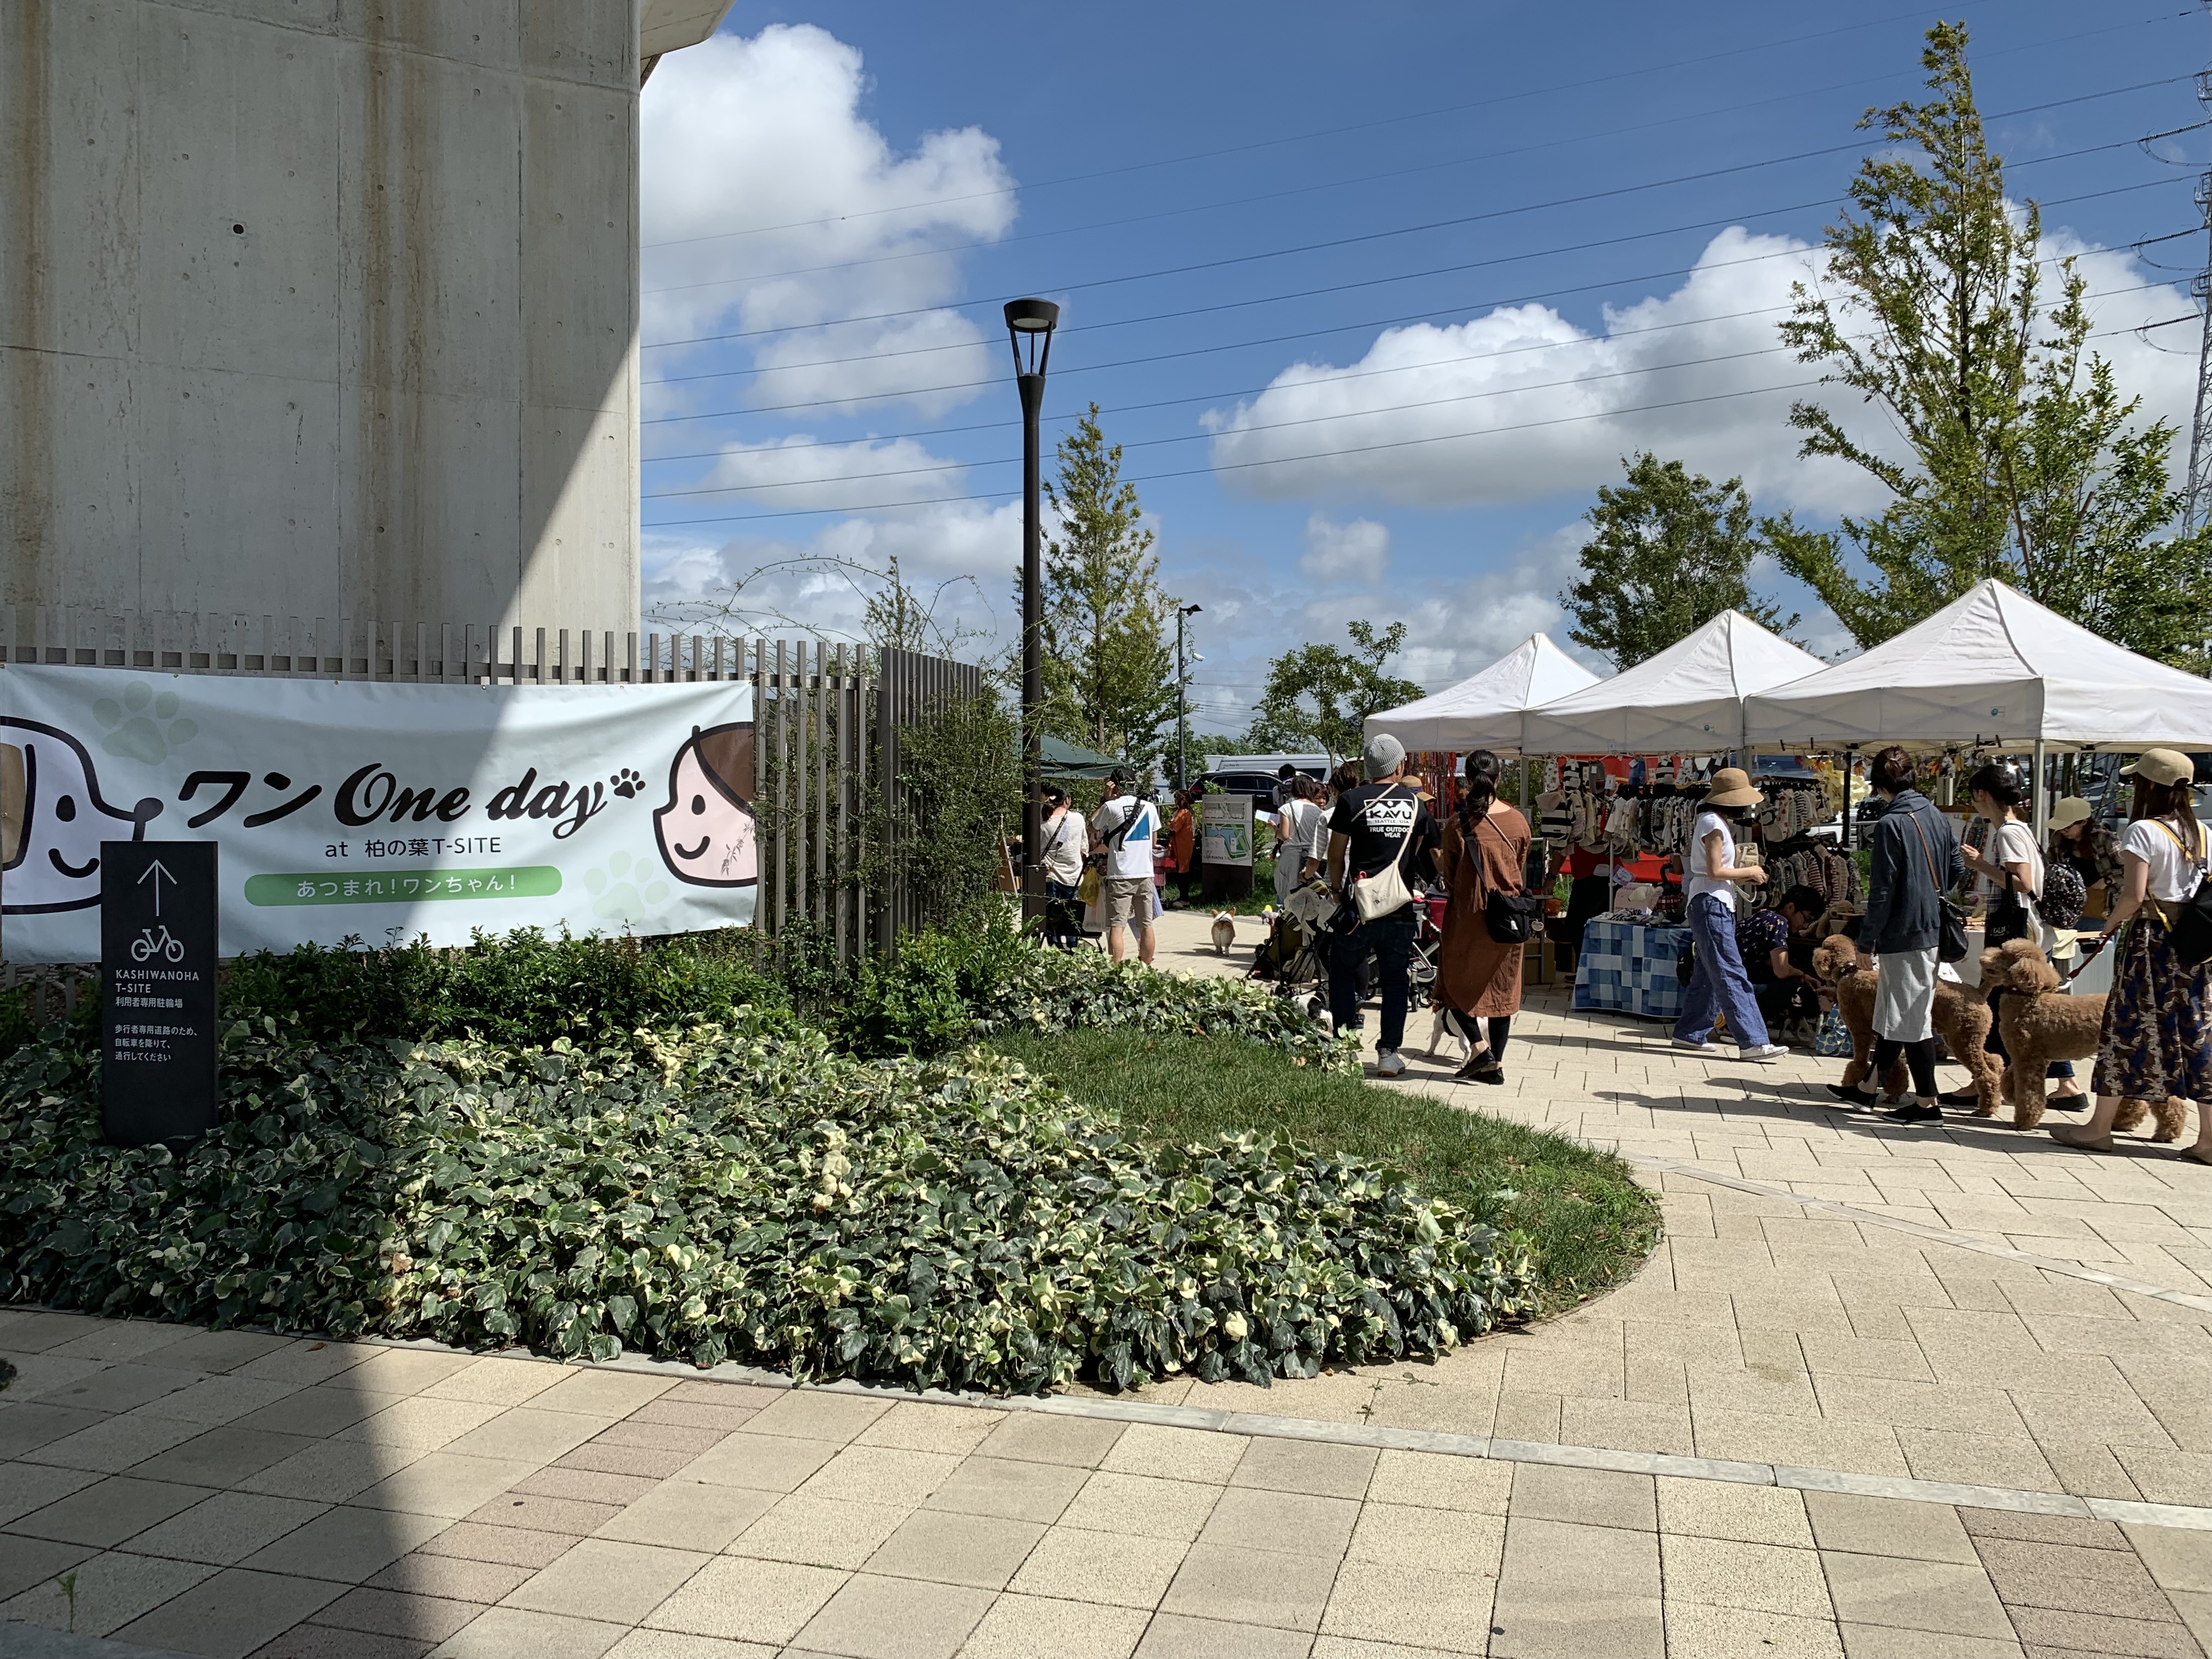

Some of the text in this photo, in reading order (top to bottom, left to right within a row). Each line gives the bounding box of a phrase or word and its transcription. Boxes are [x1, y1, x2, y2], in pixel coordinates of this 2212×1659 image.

[178, 763, 608, 839] ワン One day
[1370, 810, 1412, 820] KAVU
[325, 837, 501, 857] at 柏の葉T-SITE
[116, 969, 200, 981] KASHIWANOHA
[115, 983, 151, 993] T-SITE
[115, 997, 183, 1008] 利用者専用駐輪場
[115, 1024, 198, 1036] 歩行者専用道路のため、
[115, 1038, 171, 1049] 自転車を降りて、
[115, 1051, 171, 1062] 通行してください
